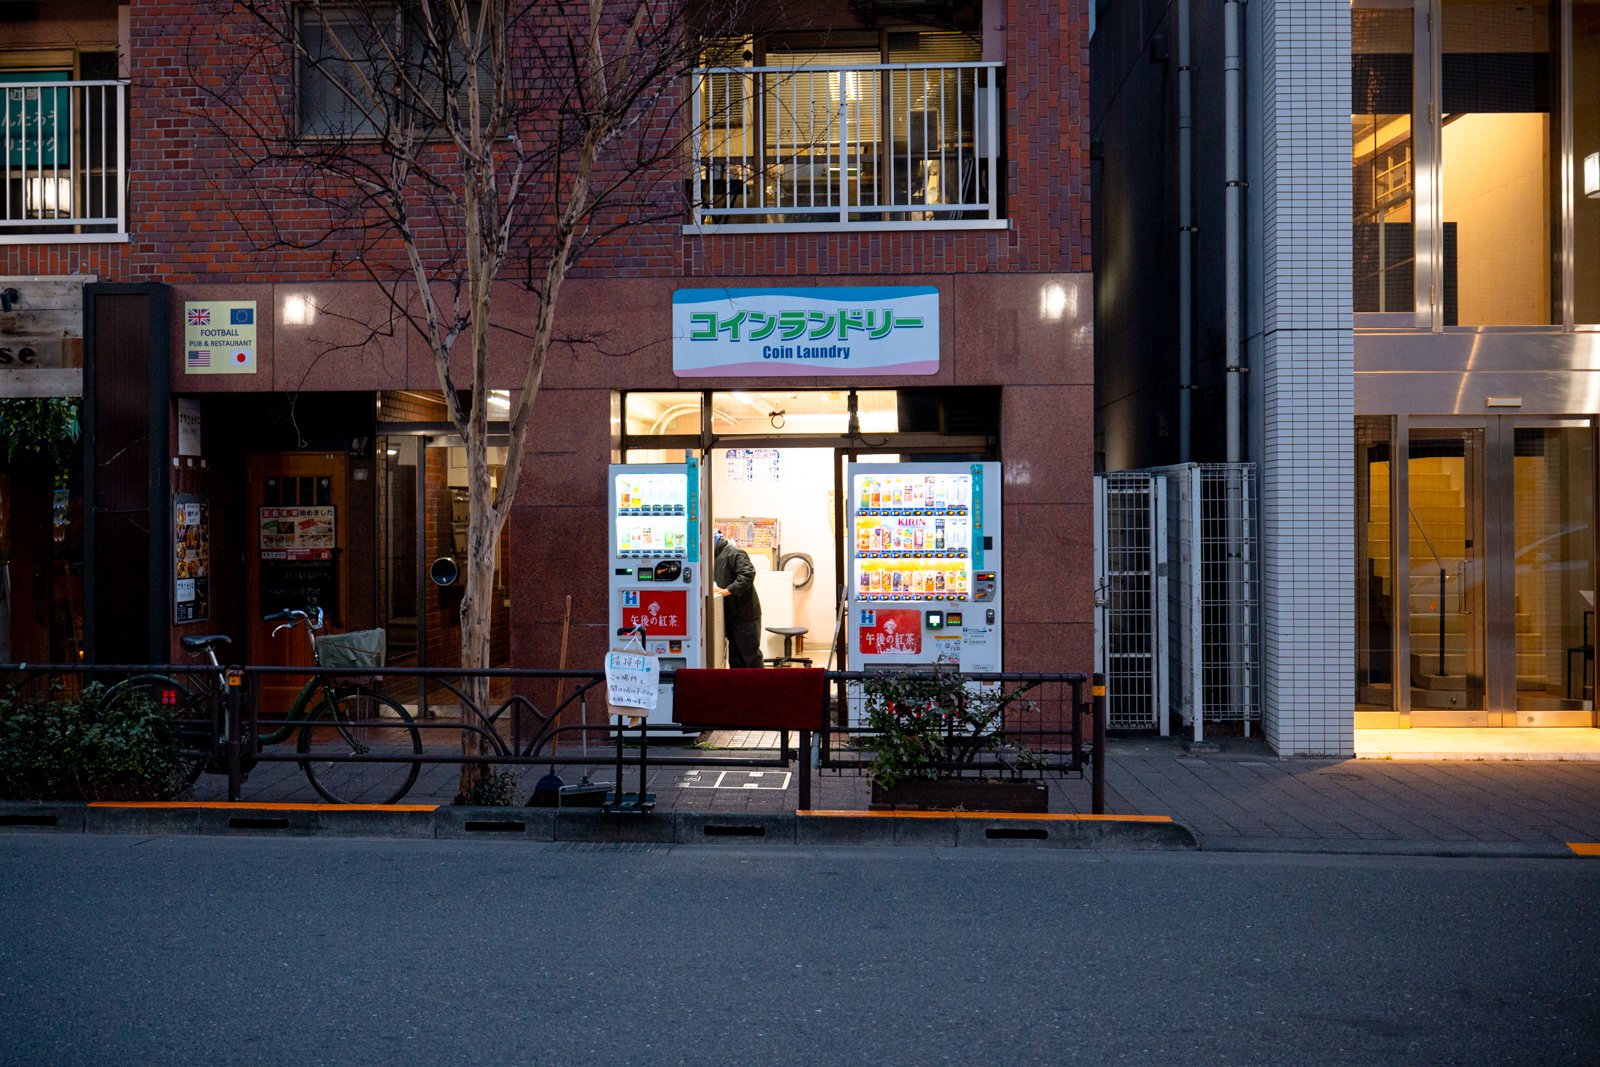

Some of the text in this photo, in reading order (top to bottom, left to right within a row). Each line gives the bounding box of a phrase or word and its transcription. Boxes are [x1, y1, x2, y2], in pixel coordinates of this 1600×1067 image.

[690, 309, 924, 342] コインランドリー
[200, 329, 239, 337] FOOTBALL
[763, 344, 851, 360] Coin Laundry
[898, 518, 926, 526] KIRIN
[630, 614, 678, 627] 午後の紅茶
[865, 632, 916, 646] 午後の紅茶
